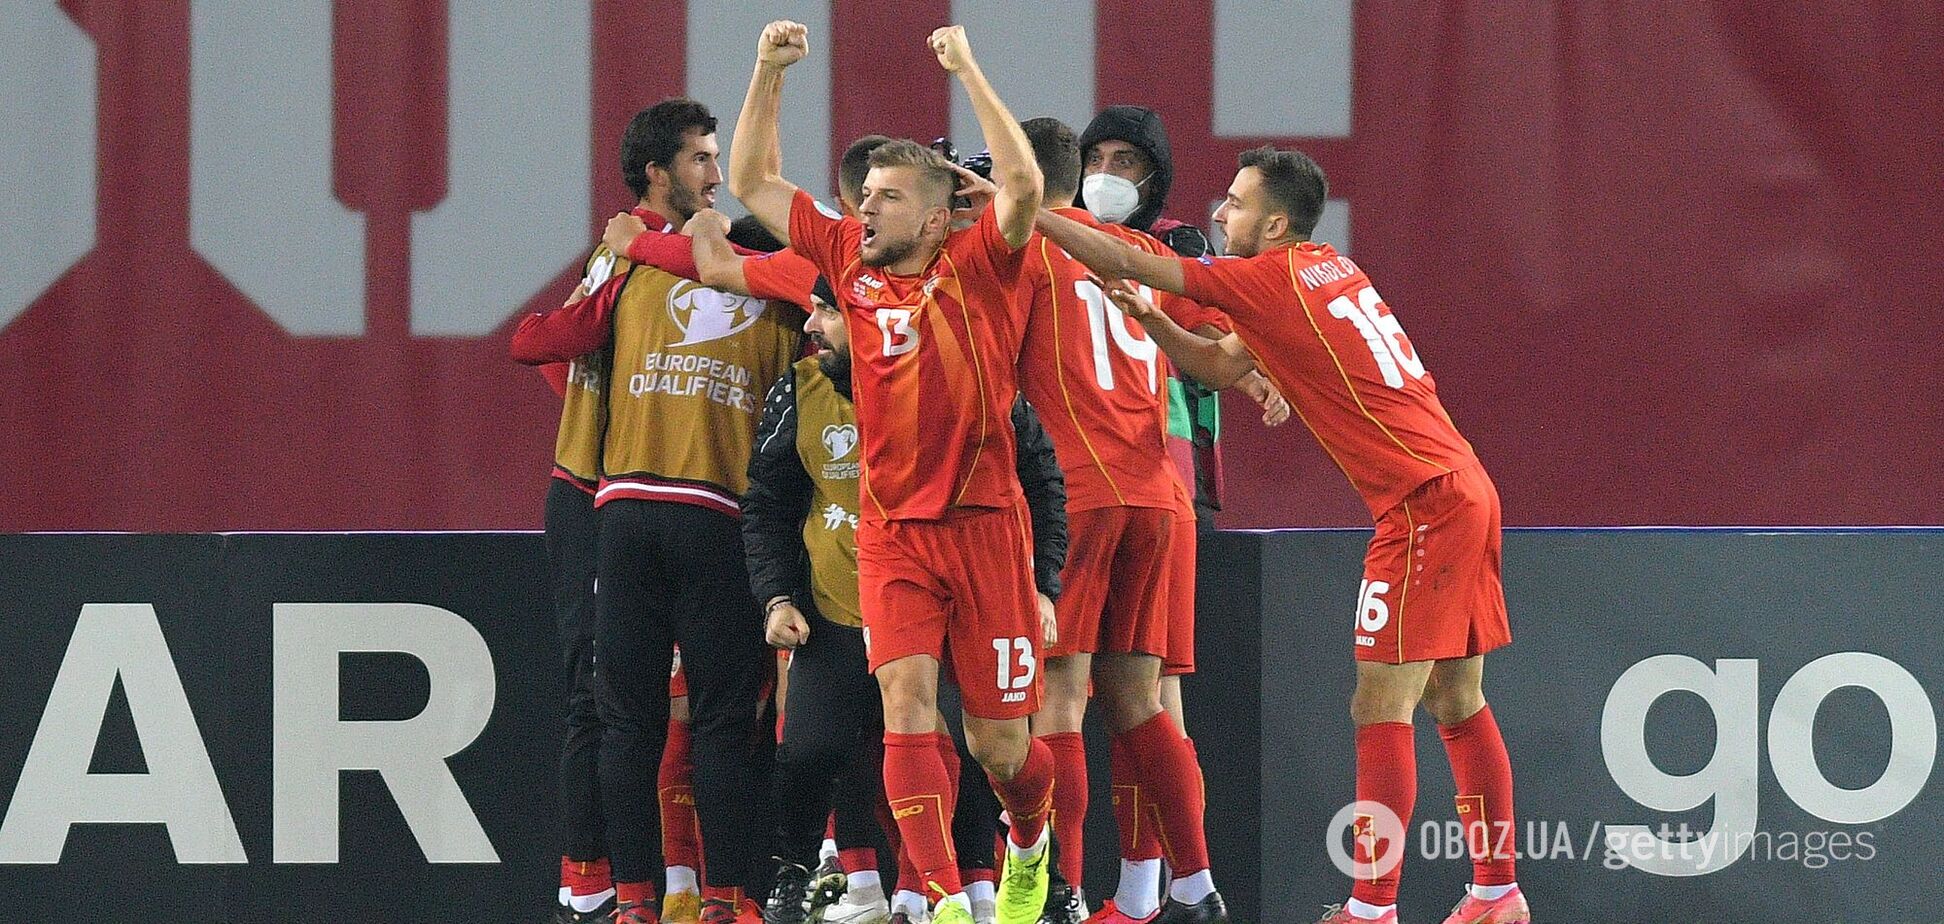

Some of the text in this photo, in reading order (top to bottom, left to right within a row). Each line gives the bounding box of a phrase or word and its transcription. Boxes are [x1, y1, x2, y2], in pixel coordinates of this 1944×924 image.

[875, 308, 919, 357] 13
[1327, 285, 1426, 389] 16
[628, 373, 757, 414] QUALIFIERS
[645, 352, 750, 387] EUROPEAN
[993, 636, 1035, 690] 13
[1001, 691, 1027, 703] JAKO
[0, 602, 502, 864] AR
[1600, 651, 1938, 877] go
